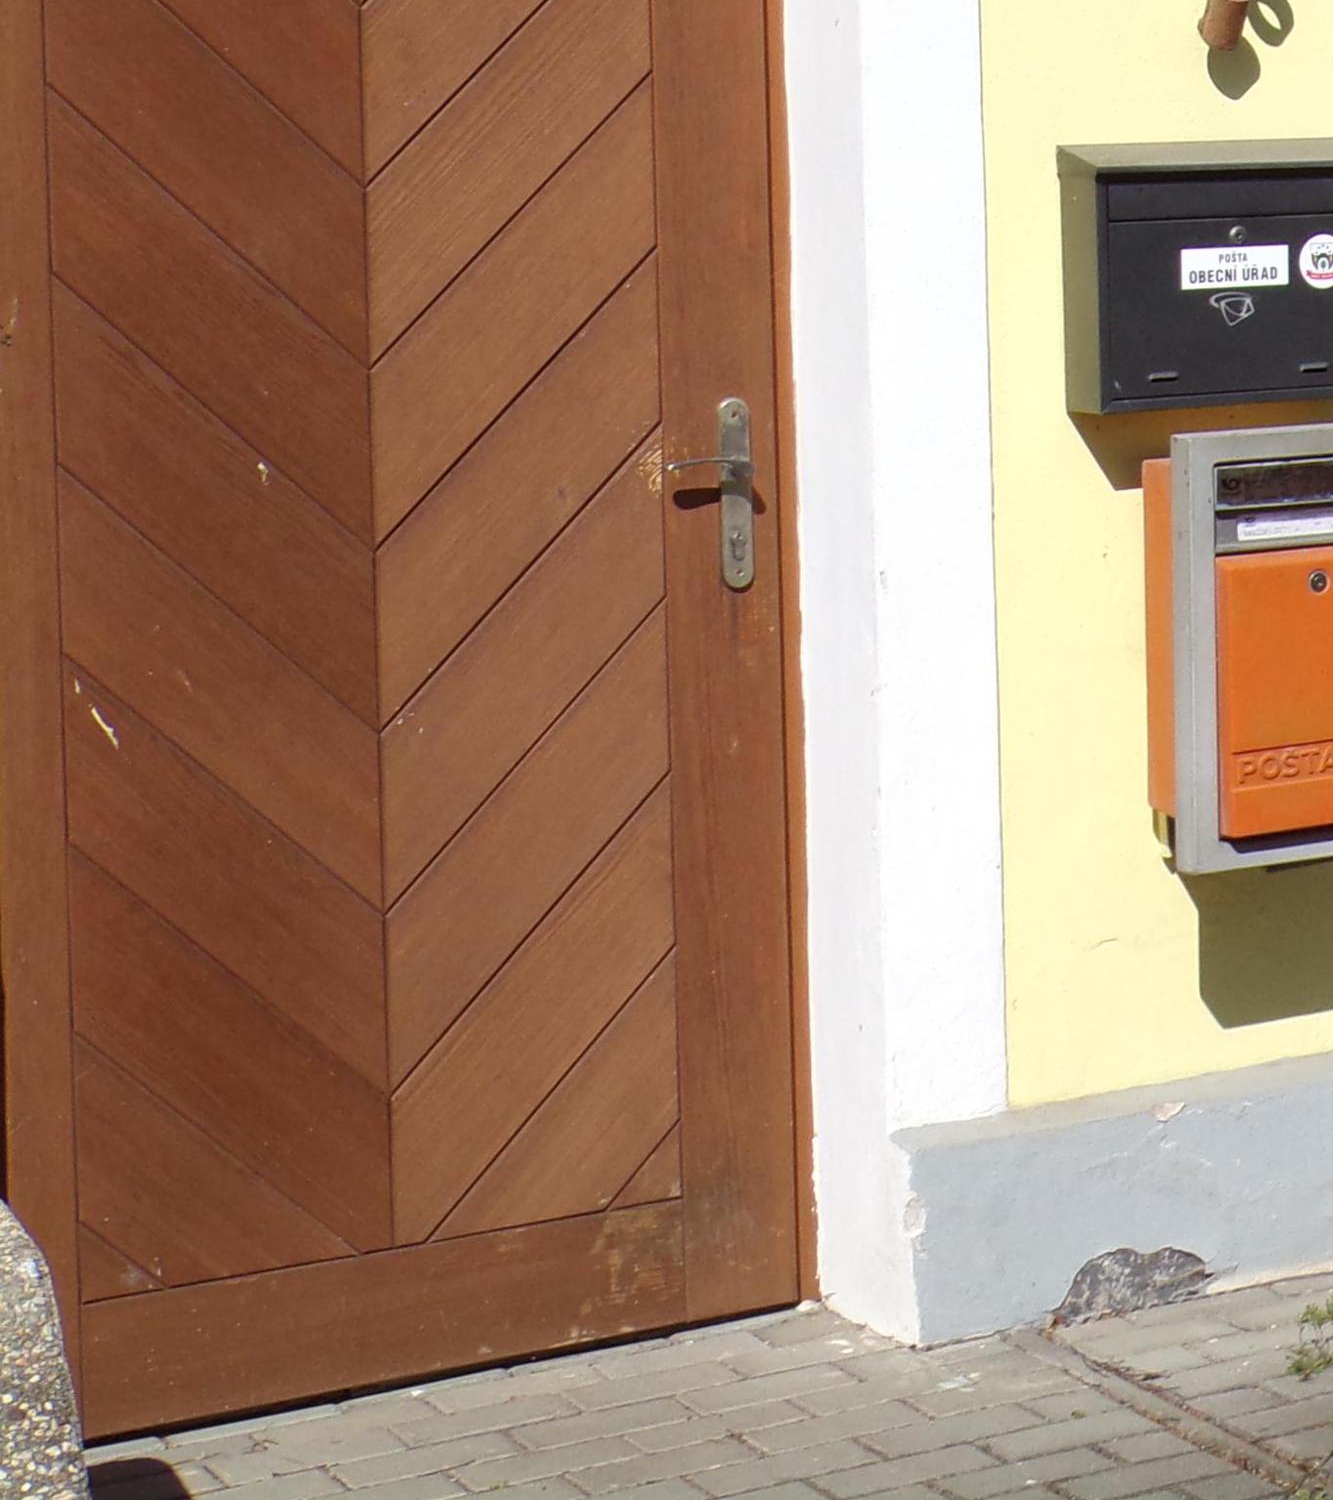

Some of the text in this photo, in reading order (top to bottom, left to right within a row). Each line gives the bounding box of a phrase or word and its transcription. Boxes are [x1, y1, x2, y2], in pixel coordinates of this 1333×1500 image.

[1218, 250, 1249, 264] POŠTA
[1188, 263, 1279, 285] OBECNÍ ÚŘAD
